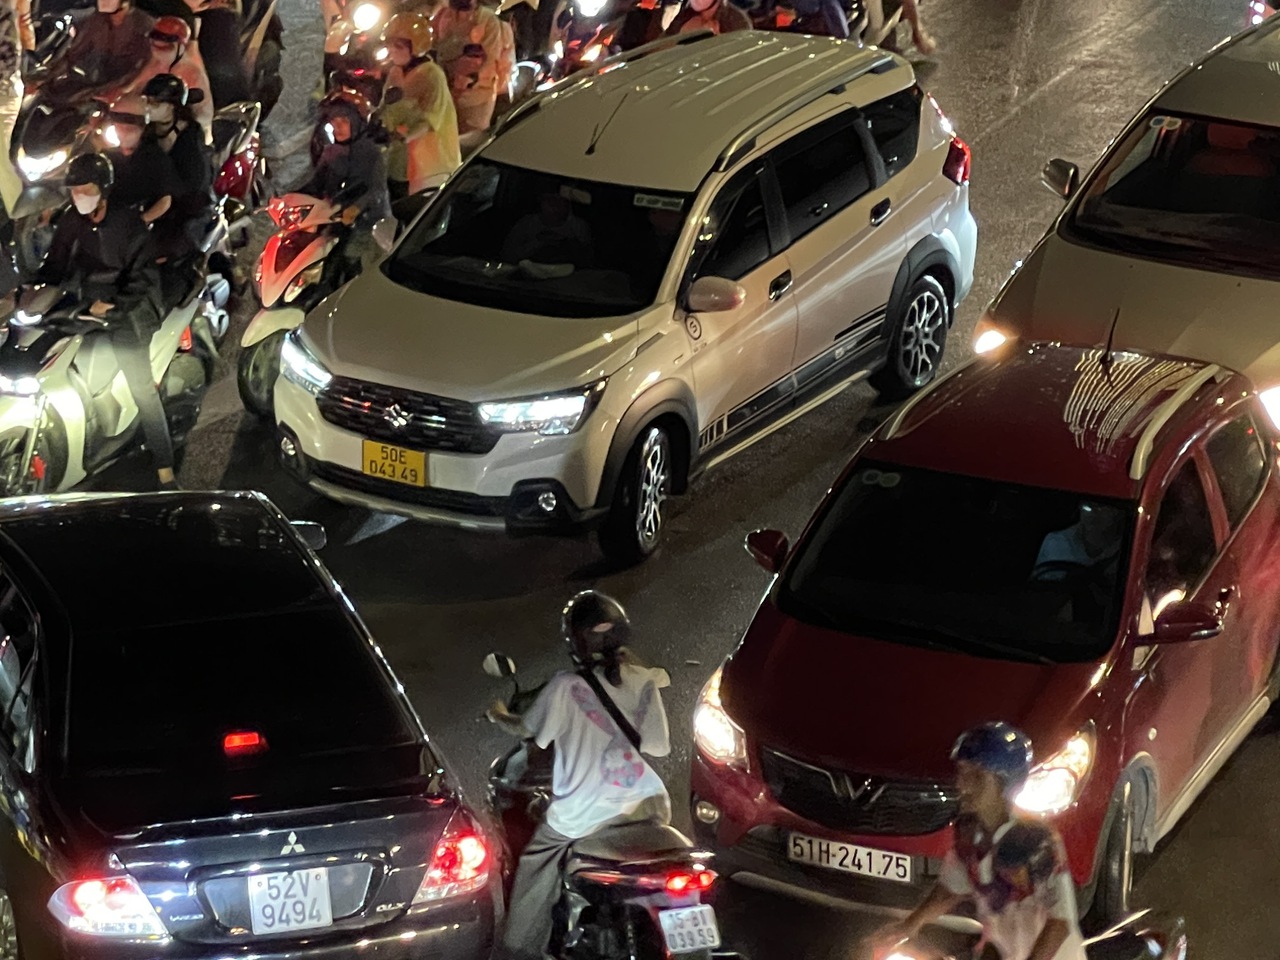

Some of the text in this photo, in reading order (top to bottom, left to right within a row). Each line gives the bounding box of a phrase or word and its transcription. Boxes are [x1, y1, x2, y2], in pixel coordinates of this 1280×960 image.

[381, 445, 407, 465] 50E
[792, 836, 908, 879] 51H-241.75
[267, 872, 310, 901] 52V
[261, 897, 322, 928] 9494
